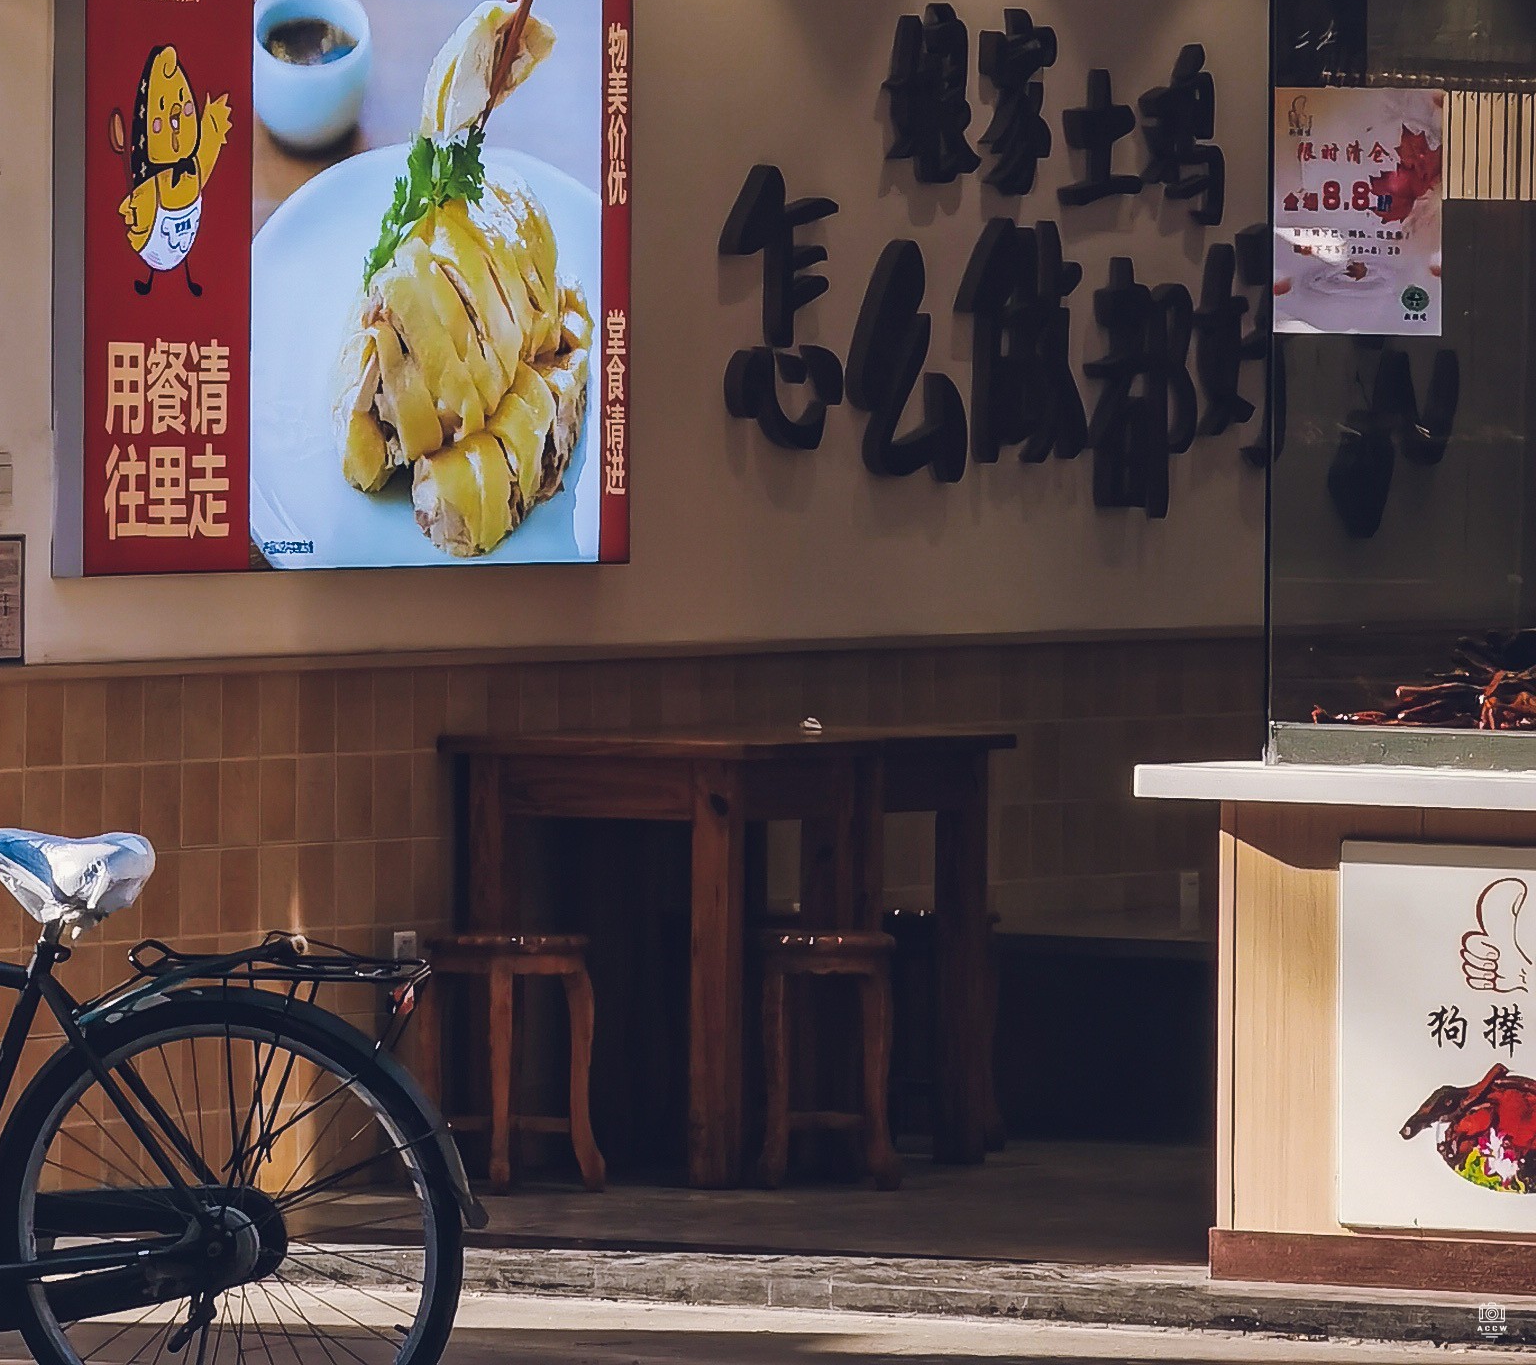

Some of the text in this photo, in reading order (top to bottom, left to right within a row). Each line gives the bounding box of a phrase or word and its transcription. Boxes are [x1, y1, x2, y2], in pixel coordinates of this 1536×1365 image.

[607, 23, 628, 205] 物美价优
[104, 339, 231, 436] 用餐请
[605, 309, 626, 495] 堂食请进
[104, 444, 230, 540] 往里走
